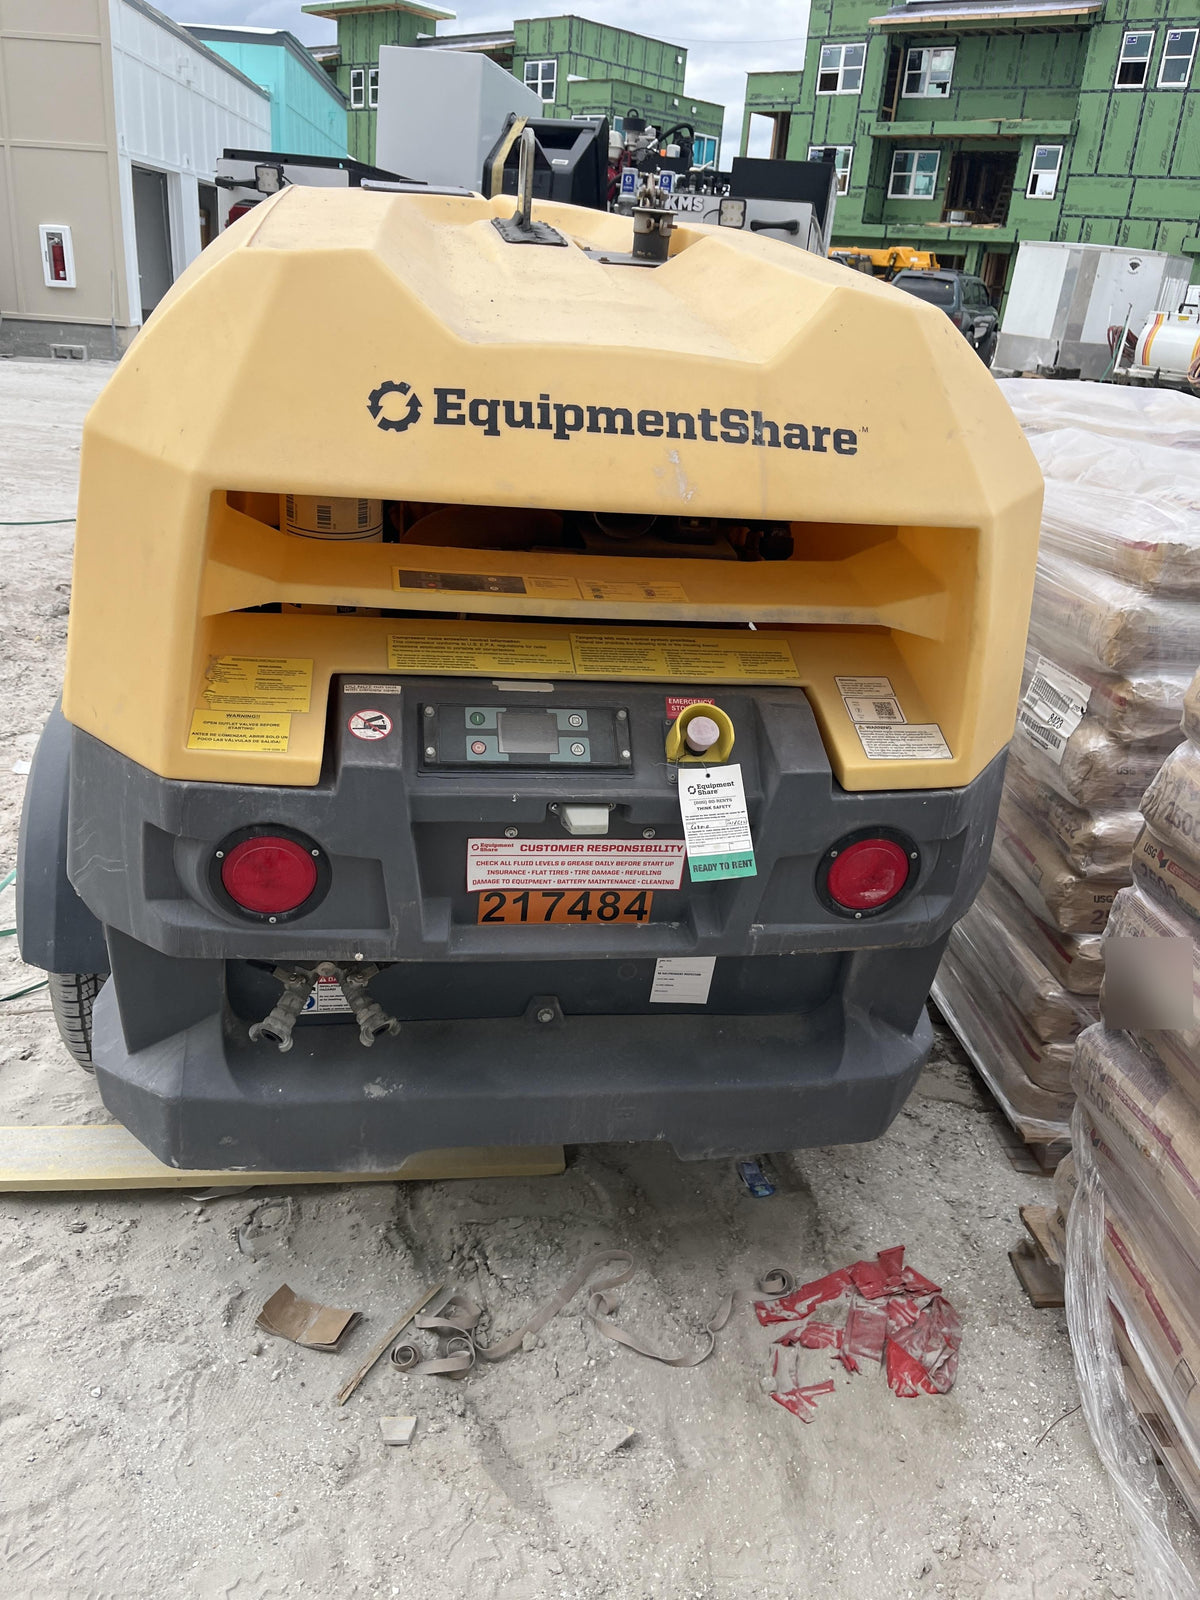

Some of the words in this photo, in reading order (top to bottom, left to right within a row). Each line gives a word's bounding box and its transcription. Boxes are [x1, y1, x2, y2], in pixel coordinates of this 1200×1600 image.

[665, 196, 704, 212] KMS
[434, 388, 857, 456] EquipmentShare
[696, 781, 735, 790] Equipment
[520, 844, 584, 852] CUSTOMER
[586, 844, 684, 853] RESPONSIBILITY
[1143, 842, 1158, 859] USG
[693, 863, 718, 873] READY
[720, 862, 730, 870] TO
[732, 859, 753, 869] RENT
[1094, 895, 1113, 903] USG
[481, 891, 648, 923] 217484
